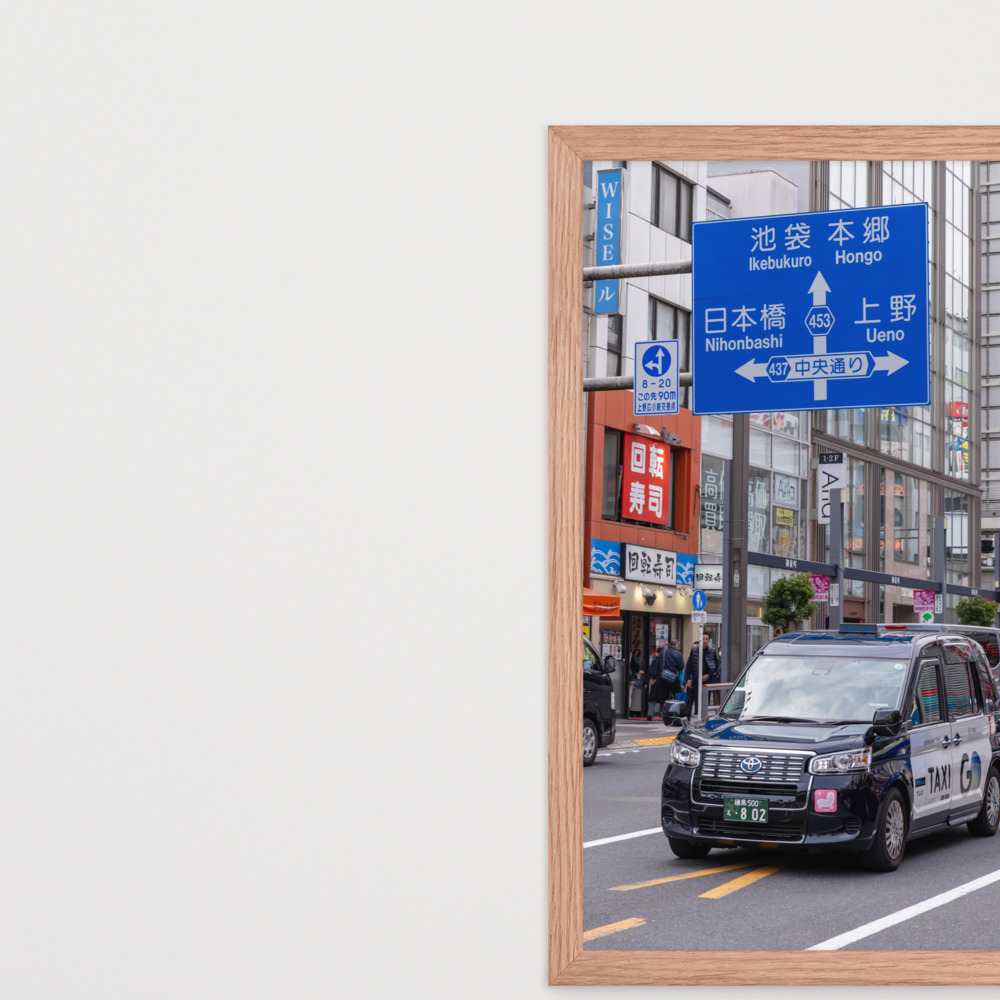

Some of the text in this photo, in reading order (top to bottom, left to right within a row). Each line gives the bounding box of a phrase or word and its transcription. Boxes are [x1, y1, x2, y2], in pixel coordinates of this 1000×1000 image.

[750, 215, 890, 253] 池袋 本郷
[749, 250, 883, 271] Ikebukuro Hongo
[705, 303, 787, 334] 日本橋
[854, 294, 917, 324] 上野
[809, 313, 831, 329] 453
[705, 334, 783, 352] Nihonbashi
[866, 328, 905, 343] Ueno
[768, 361, 789, 376] 437
[794, 356, 864, 377] 中央通り
[630, 441, 665, 480] 回転
[629, 481, 664, 518] 寿司
[928, 763, 951, 794] TAXI
[747, 799, 759, 807] 500
